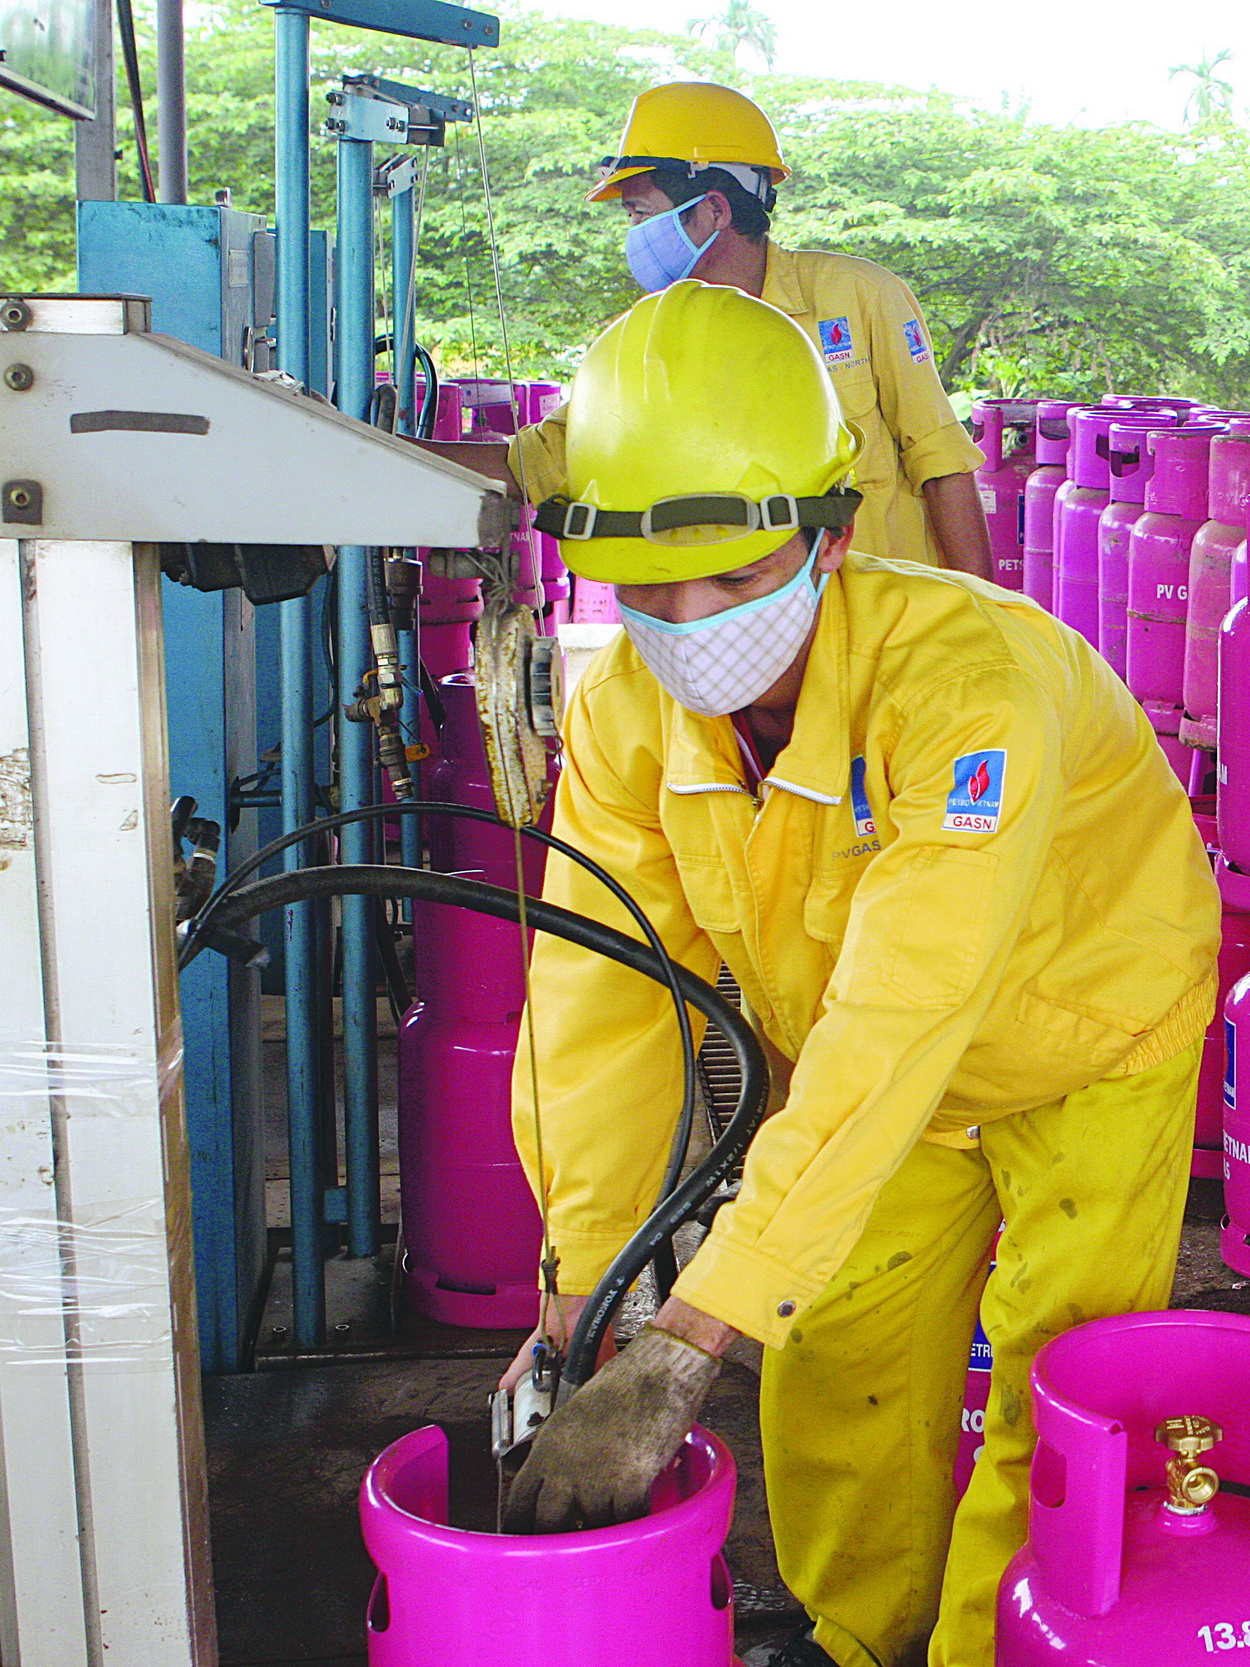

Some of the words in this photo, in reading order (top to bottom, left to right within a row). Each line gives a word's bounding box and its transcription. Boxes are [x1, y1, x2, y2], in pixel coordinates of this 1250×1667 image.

[828, 351, 851, 362] GASN
[1156, 584, 1174, 600] PV
[953, 815, 992, 830] GASN
